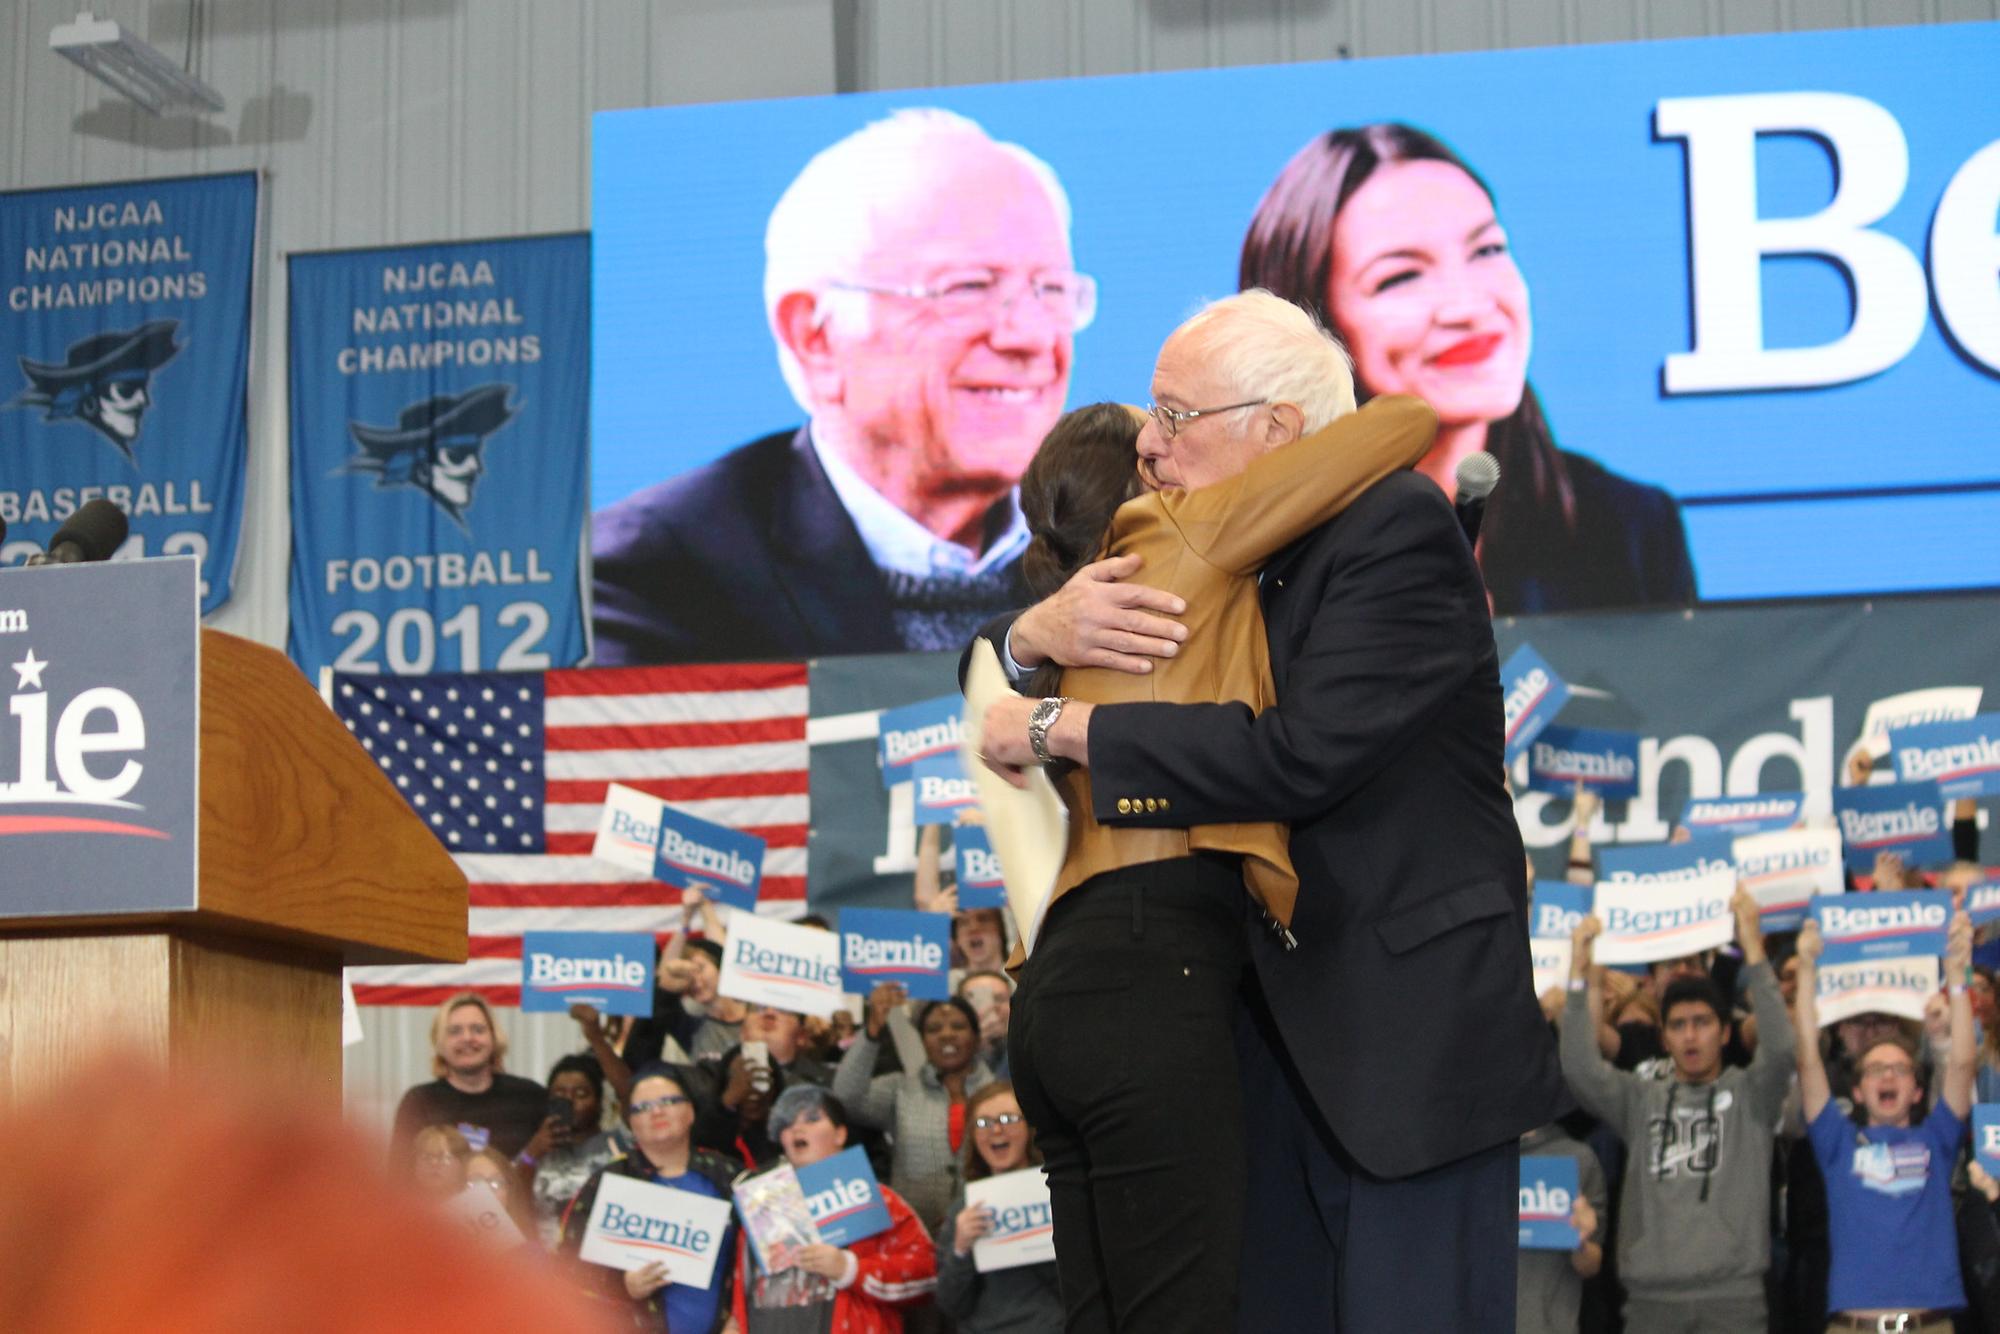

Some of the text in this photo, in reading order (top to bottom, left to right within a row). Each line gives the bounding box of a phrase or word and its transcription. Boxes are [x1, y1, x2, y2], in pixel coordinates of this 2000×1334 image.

[55, 200, 164, 232] NJCAA
[25, 236, 192, 271] NATIONAL
[9, 272, 207, 310] CHAMPIONS
[384, 261, 495, 291] NJCAA
[354, 299, 523, 333] NATIONAL
[338, 336, 541, 374] CHAMPIONS
[327, 550, 552, 593] FOOTBALL
[331, 602, 551, 675] 2012
[1534, 743, 1635, 777] Bernie
[1689, 799, 1798, 823] Bernie
[1841, 802, 1939, 844] Bernie
[662, 826, 756, 884] Bernie
[1735, 848, 1831, 876] ernie
[1605, 898, 1726, 935] Bernie
[1820, 902, 1947, 936] Bernie
[735, 938, 841, 986] Bernie
[844, 932, 943, 971] Bernie
[529, 953, 647, 988] Bernie
[1819, 966, 1929, 994] Bernie
[601, 1201, 710, 1253] Bernie
